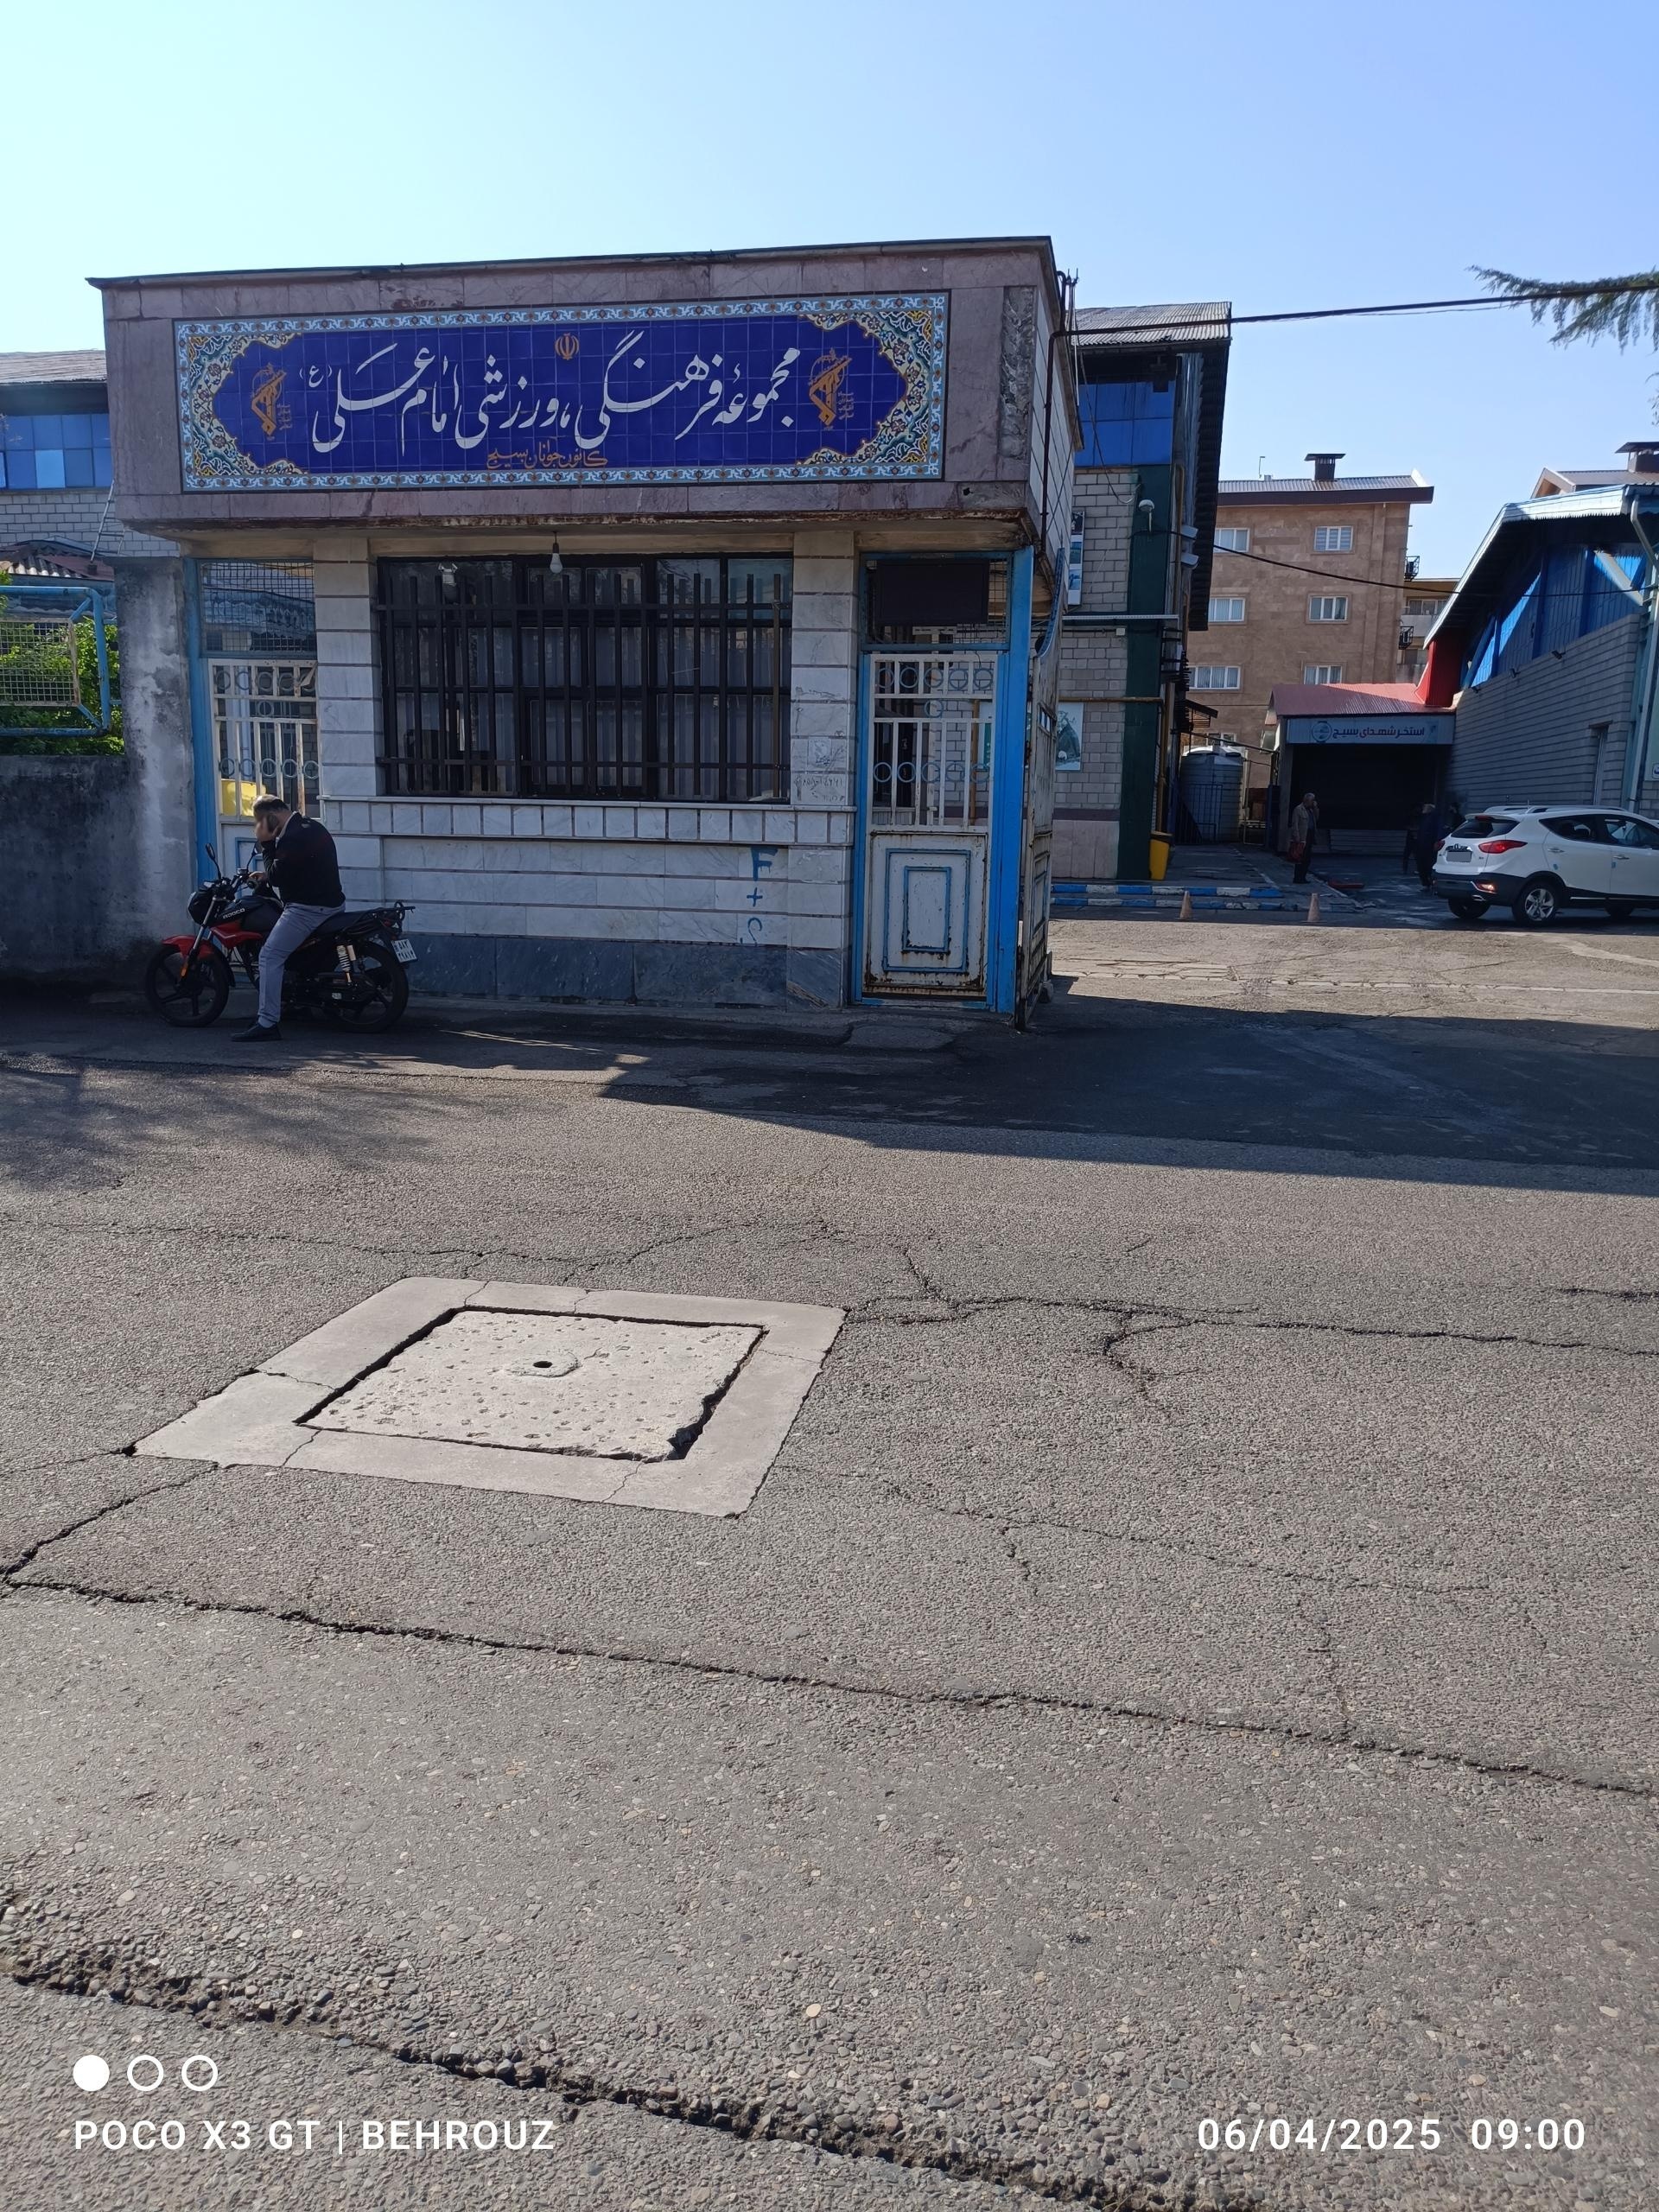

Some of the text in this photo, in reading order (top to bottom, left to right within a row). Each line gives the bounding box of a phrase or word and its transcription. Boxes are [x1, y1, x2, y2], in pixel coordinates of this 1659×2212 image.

[401, 355, 460, 457] امام
[574, 329, 723, 449] فرهنگی
[486, 439, 608, 470] کانون جوانان بسیج
[1332, 726, 1425, 740] استخر شهدای بسیج
[751, 847, 778, 881] F
